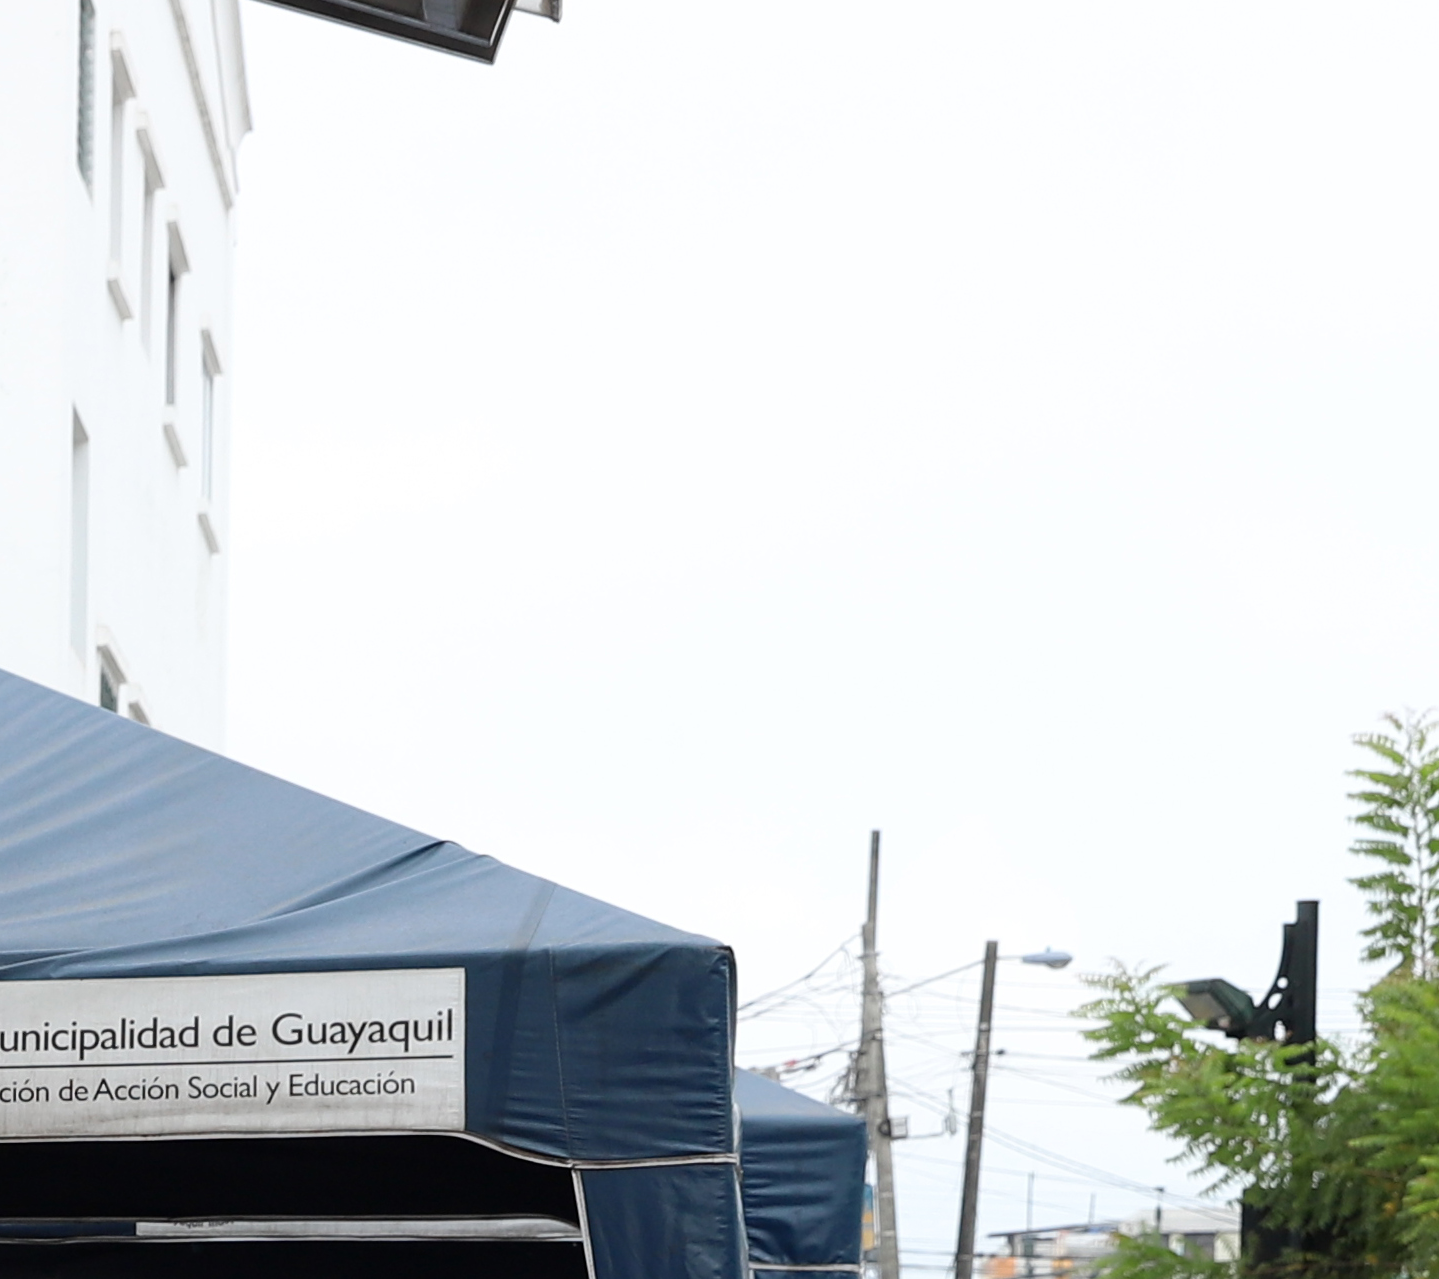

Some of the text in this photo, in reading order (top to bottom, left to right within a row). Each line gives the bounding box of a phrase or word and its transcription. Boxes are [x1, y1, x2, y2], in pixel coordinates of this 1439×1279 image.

[212, 1017, 257, 1049] de
[271, 1010, 453, 1054] Guayaquil
[57, 1078, 90, 1102] de
[92, 1076, 179, 1102] Acción
[188, 1073, 258, 1101] Social
[265, 1081, 280, 1106] y
[289, 1070, 416, 1099] Educación
